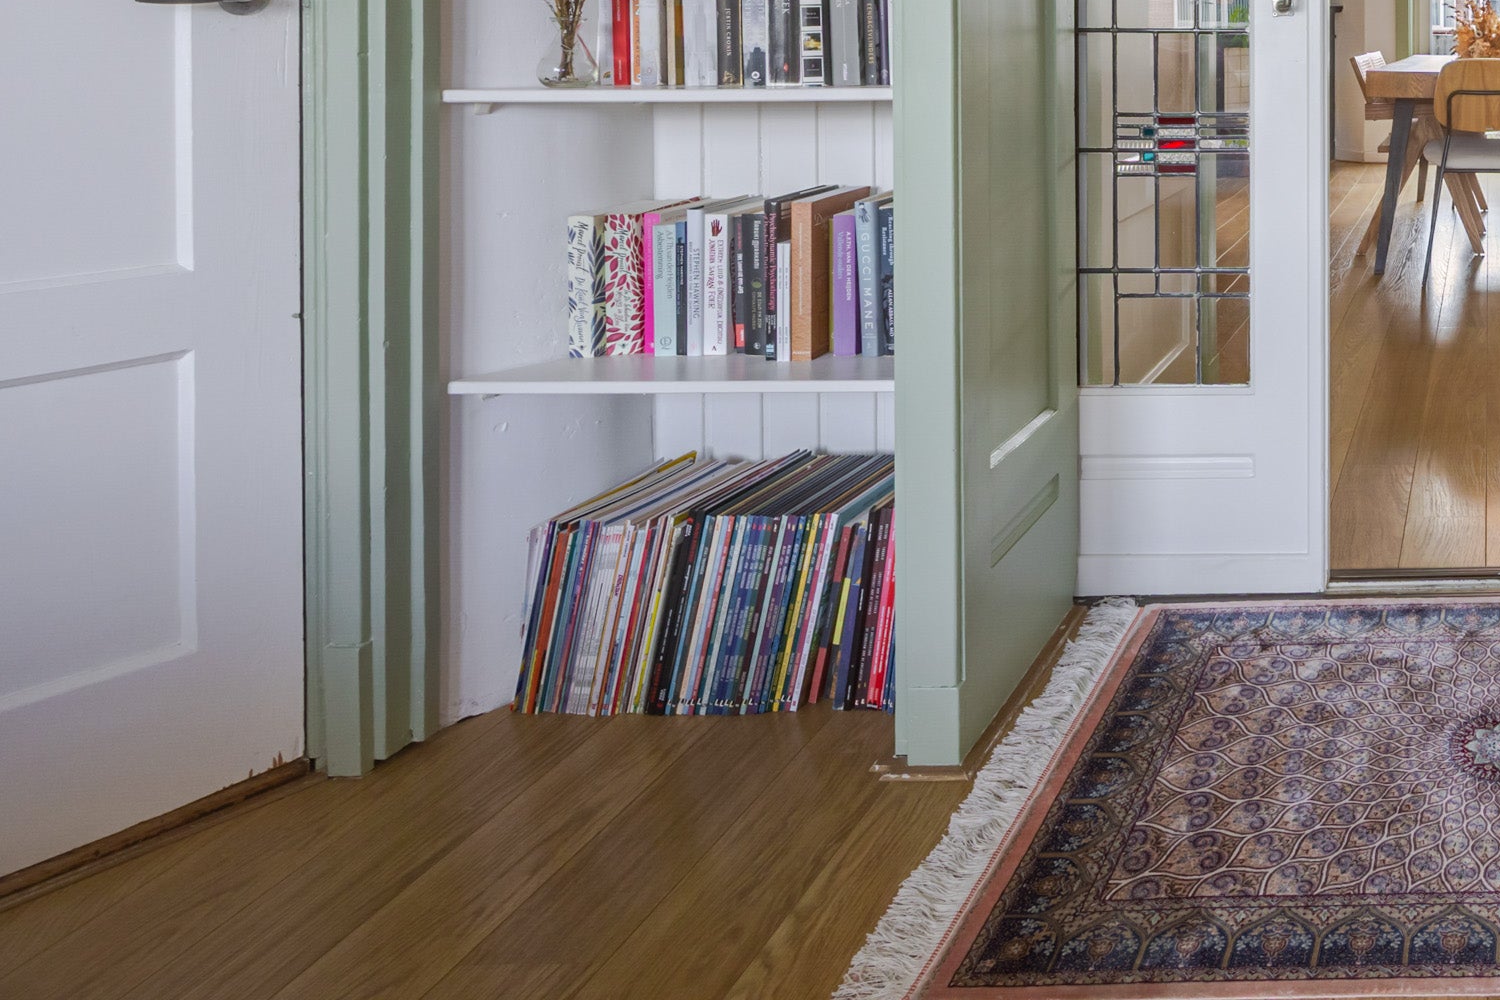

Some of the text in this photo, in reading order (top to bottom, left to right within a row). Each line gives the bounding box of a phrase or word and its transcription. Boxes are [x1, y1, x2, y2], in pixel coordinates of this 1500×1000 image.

[693, 282, 701, 319] HAWKING
[768, 213, 777, 311] Psychodynamic Psychotherapy
[861, 232, 874, 330] GUCCI MANE
